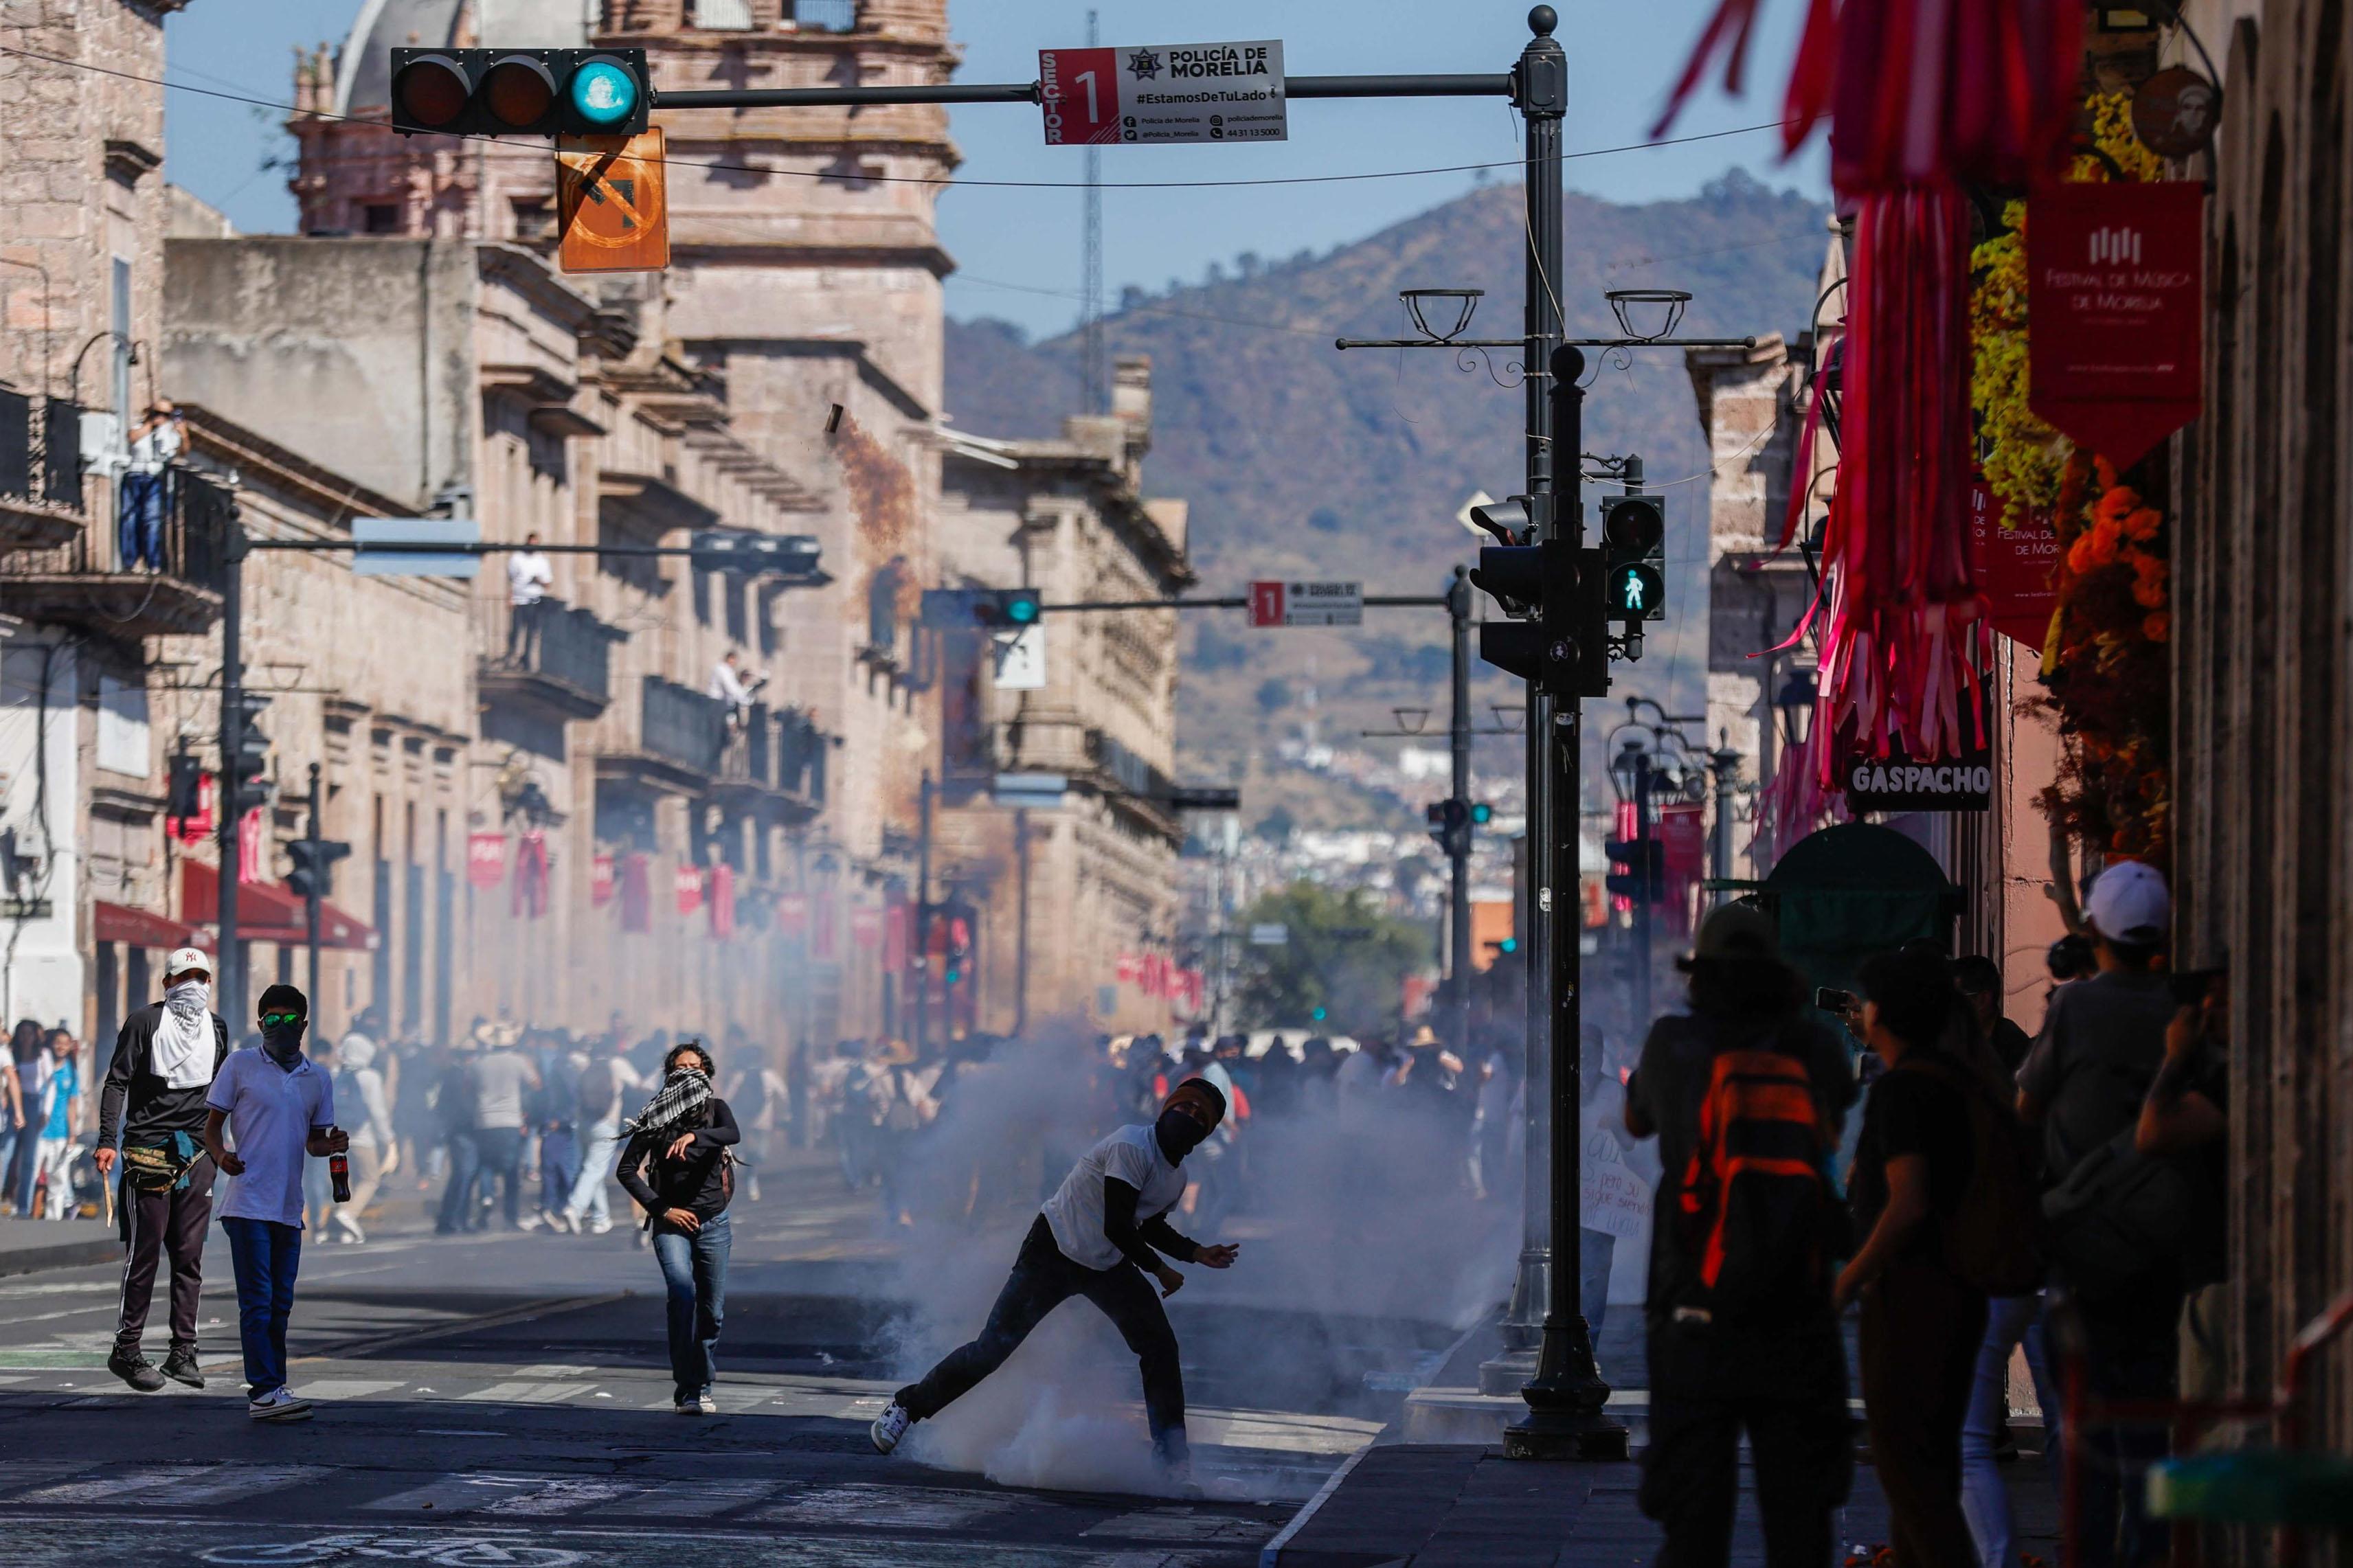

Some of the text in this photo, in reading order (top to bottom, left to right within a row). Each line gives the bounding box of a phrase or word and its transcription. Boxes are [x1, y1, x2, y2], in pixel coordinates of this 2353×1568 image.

[1170, 46, 1267, 63] POLICÍA DE
[1171, 60, 1268, 78] MORELIA
[1042, 53, 1063, 143] SECTOR
[1075, 71, 1099, 123] 1
[1137, 90, 1266, 104] #EstamosDeTuLado
[2015, 543, 2060, 555] DE MOR
[1263, 590, 1276, 617] 1
[1852, 766, 1990, 793] GASPACHO
